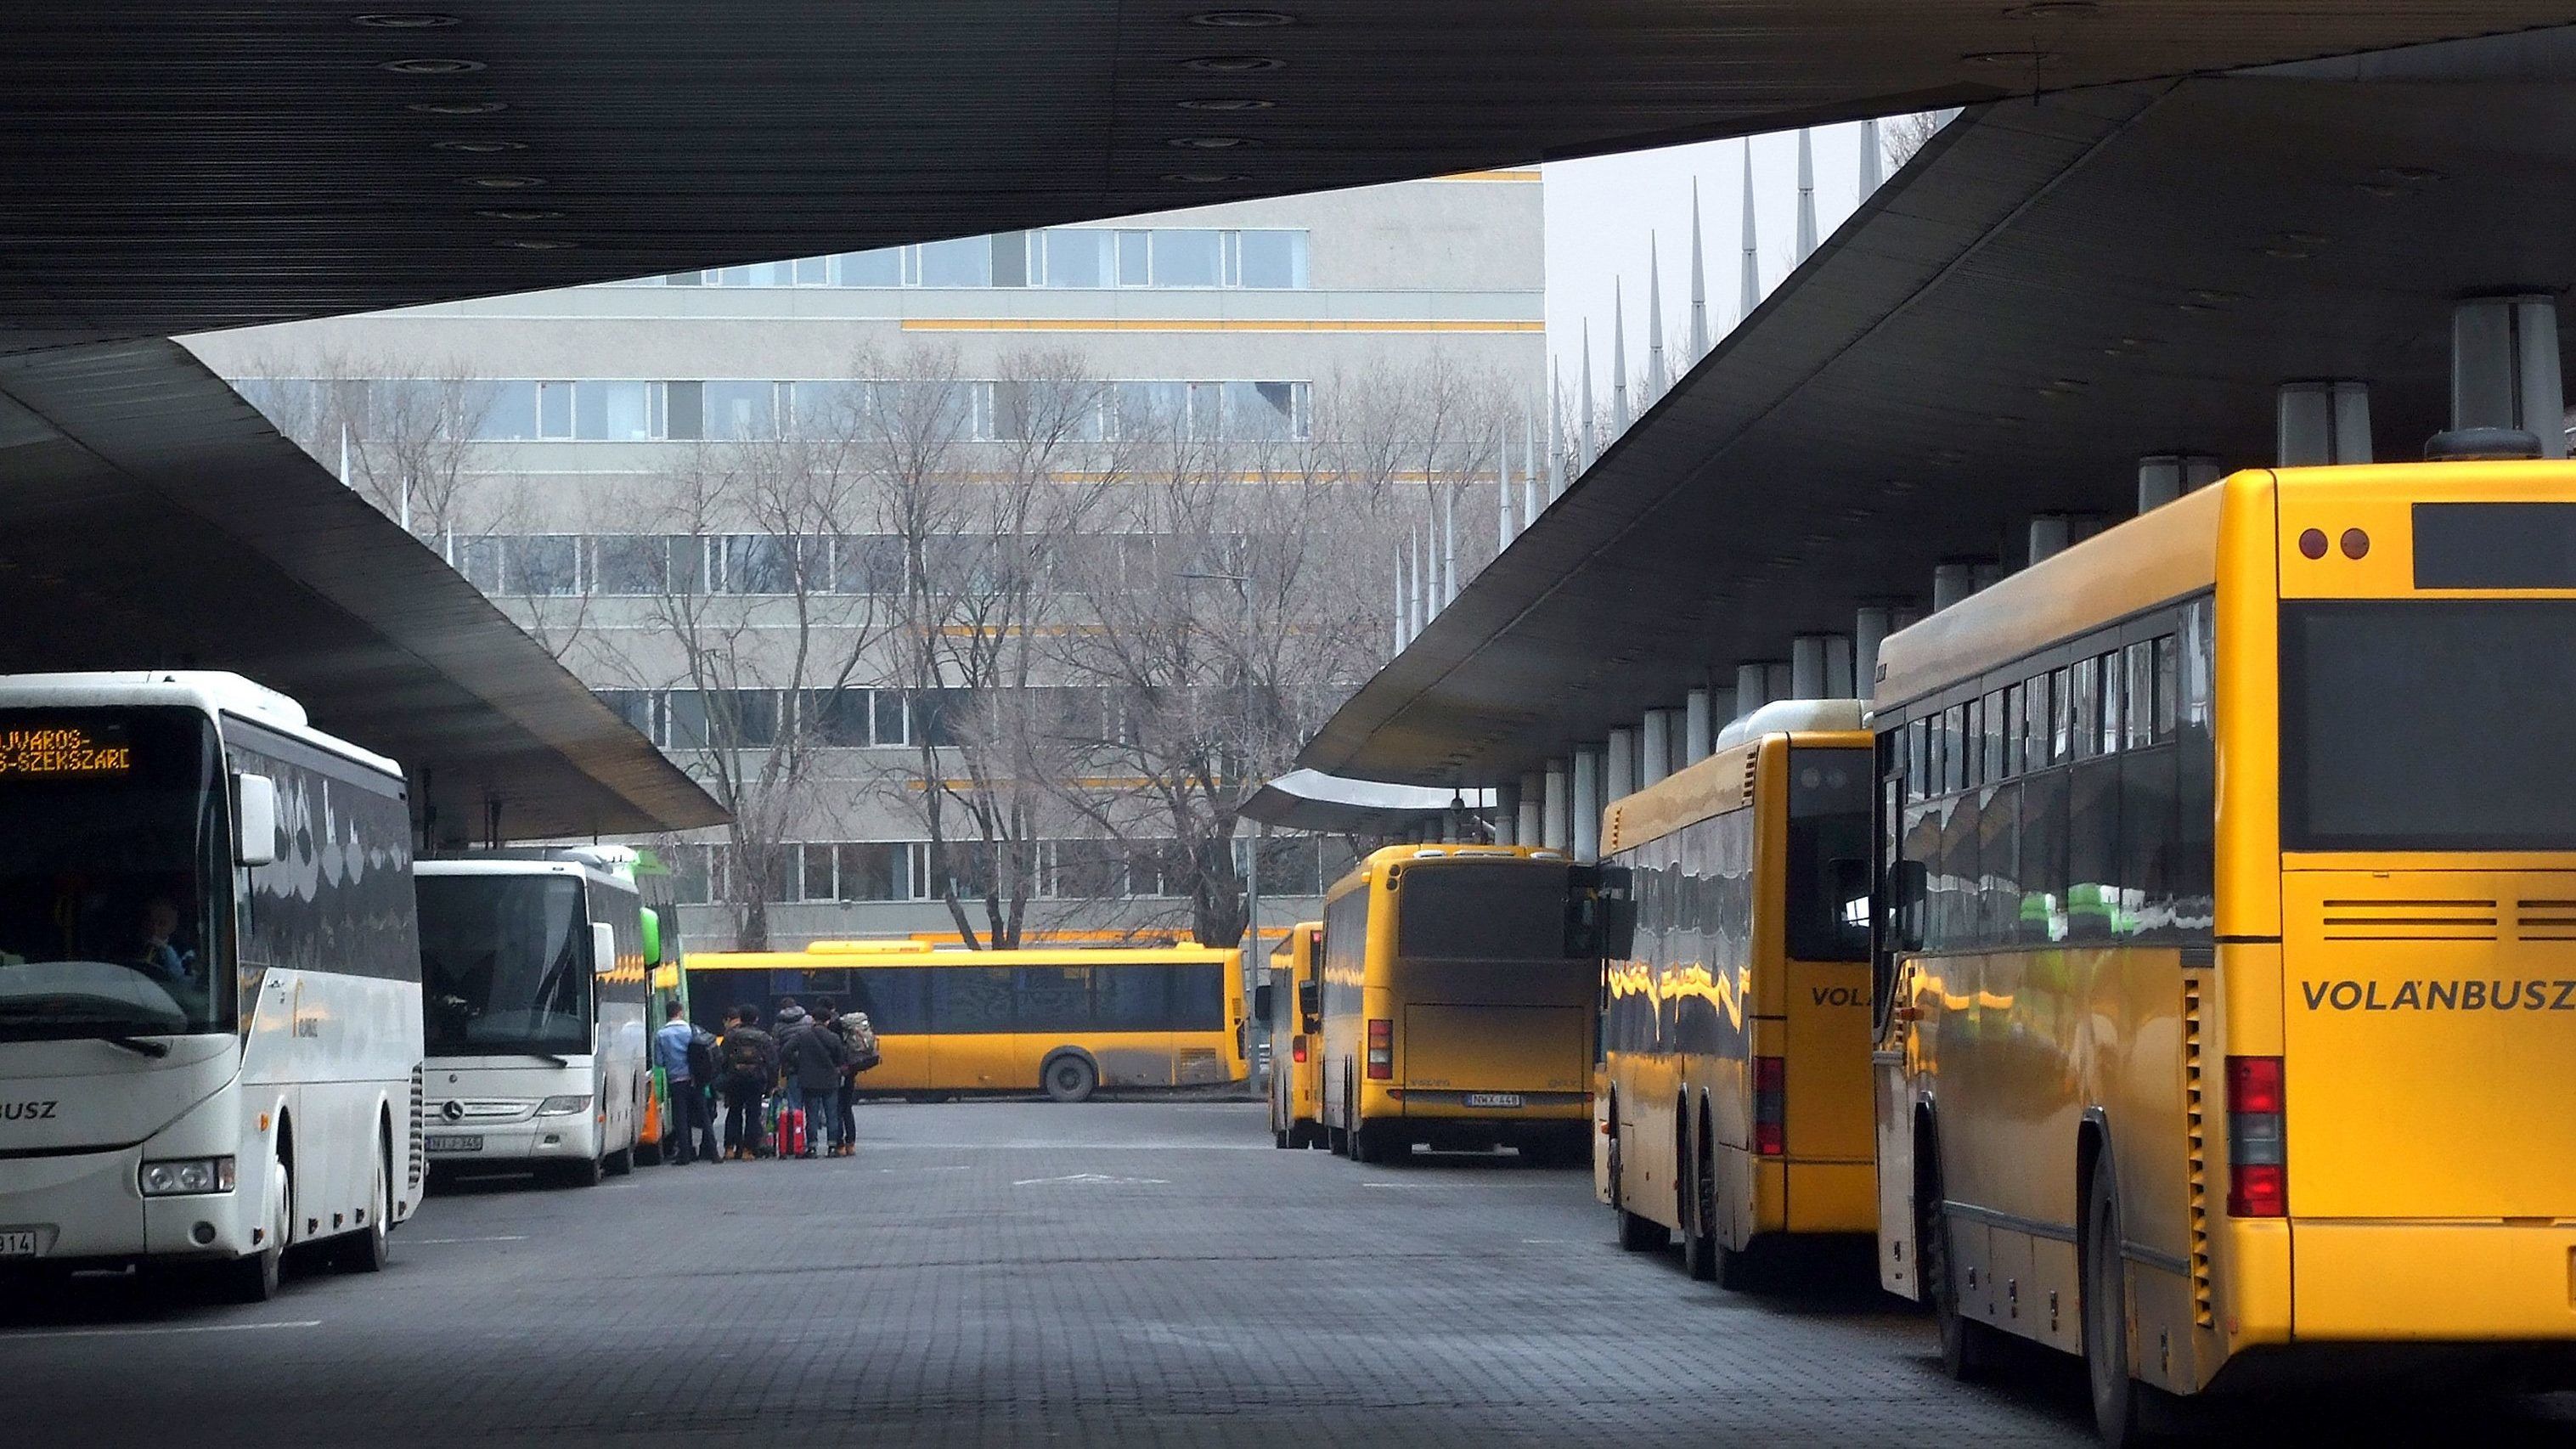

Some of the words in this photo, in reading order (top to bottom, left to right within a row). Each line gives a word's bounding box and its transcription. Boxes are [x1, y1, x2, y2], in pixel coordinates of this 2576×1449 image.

[1812, 987, 1873, 1006] VOL
[2302, 980, 2576, 1011] VOLÁNBUSZ
[0, 1101, 59, 1120] USZ
